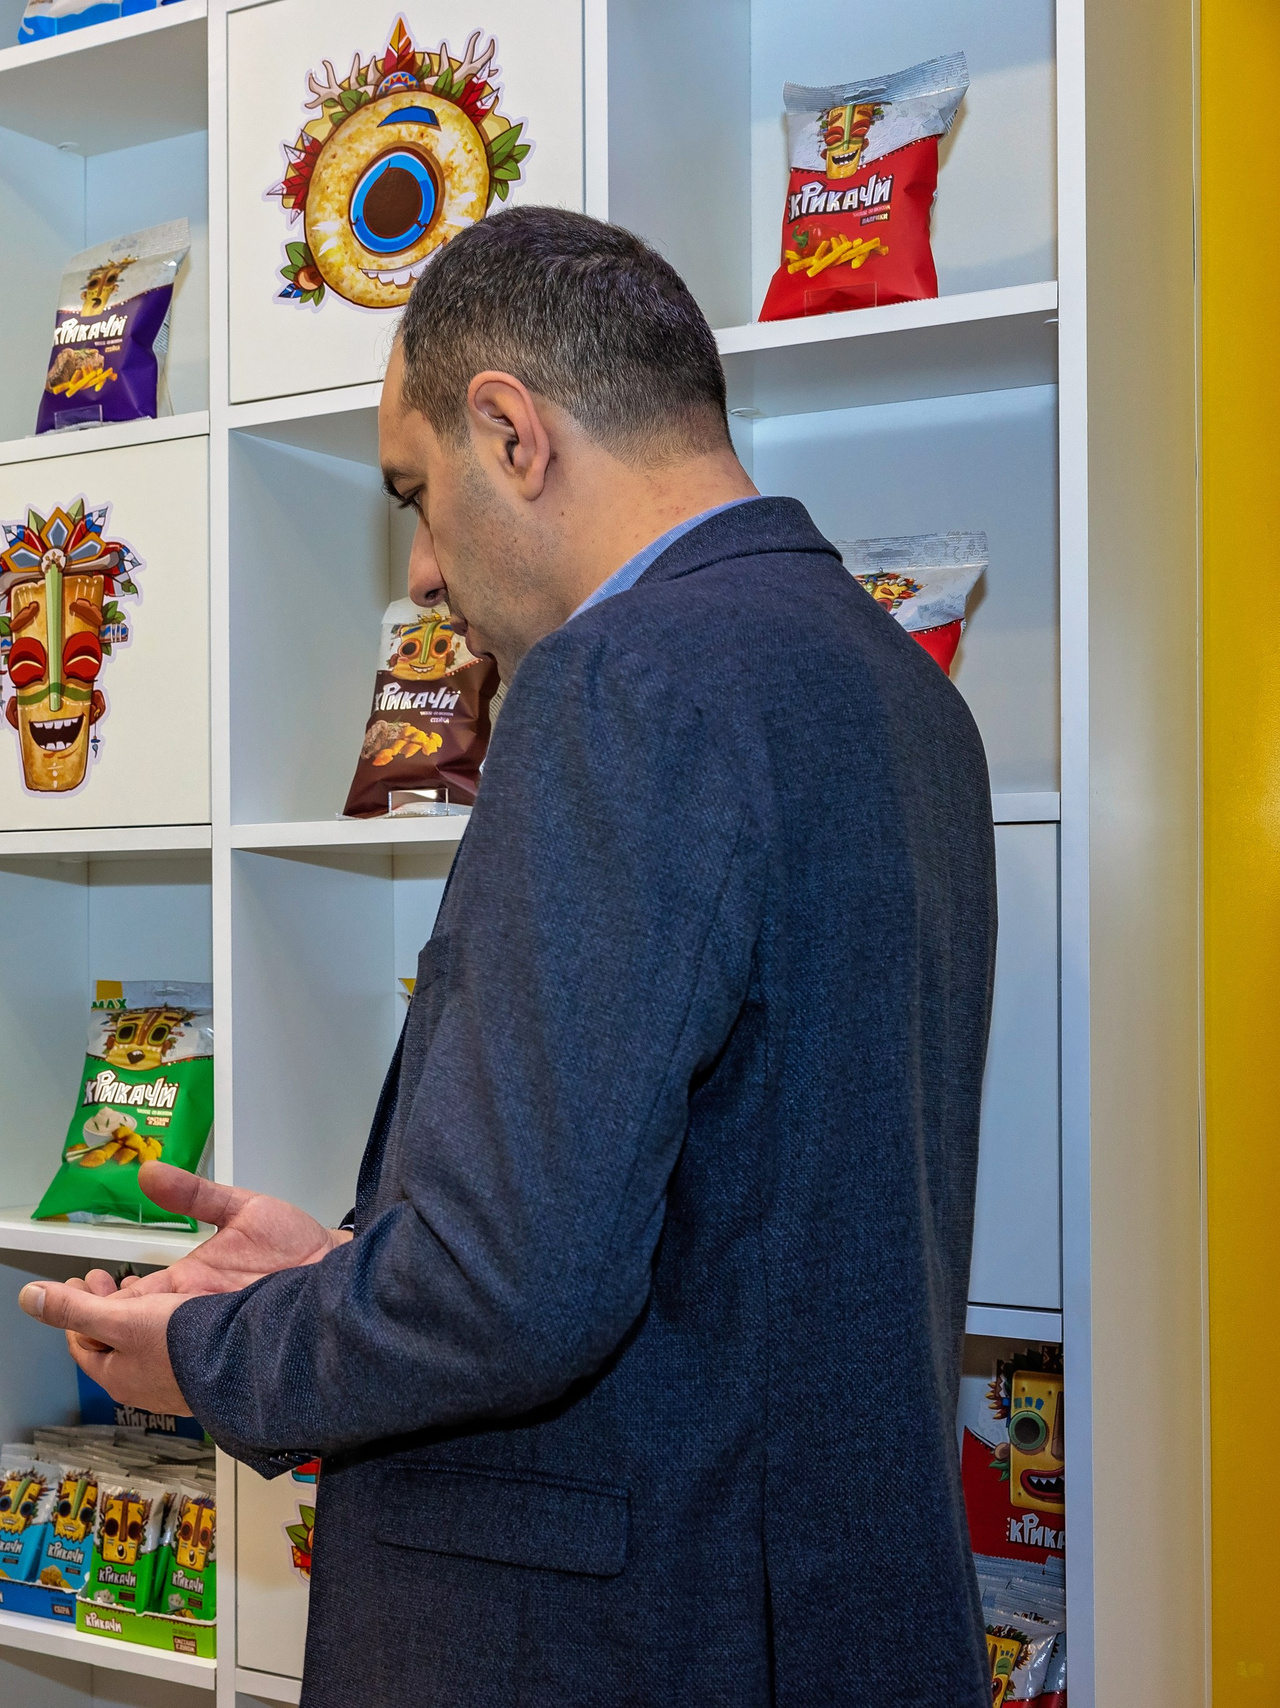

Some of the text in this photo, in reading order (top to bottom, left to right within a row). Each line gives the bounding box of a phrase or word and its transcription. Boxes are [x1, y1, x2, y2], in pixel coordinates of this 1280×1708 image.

[788, 173, 894, 220] КРИКАЧИ
[91, 998, 127, 1009] MAX
[83, 1069, 179, 1108] КРИКАЧИ
[1006, 1513, 1065, 1549] КРИКА
[98, 1565, 137, 1588] КРИКАЧИ
[171, 1569, 205, 1595] КРИКАЧИ
